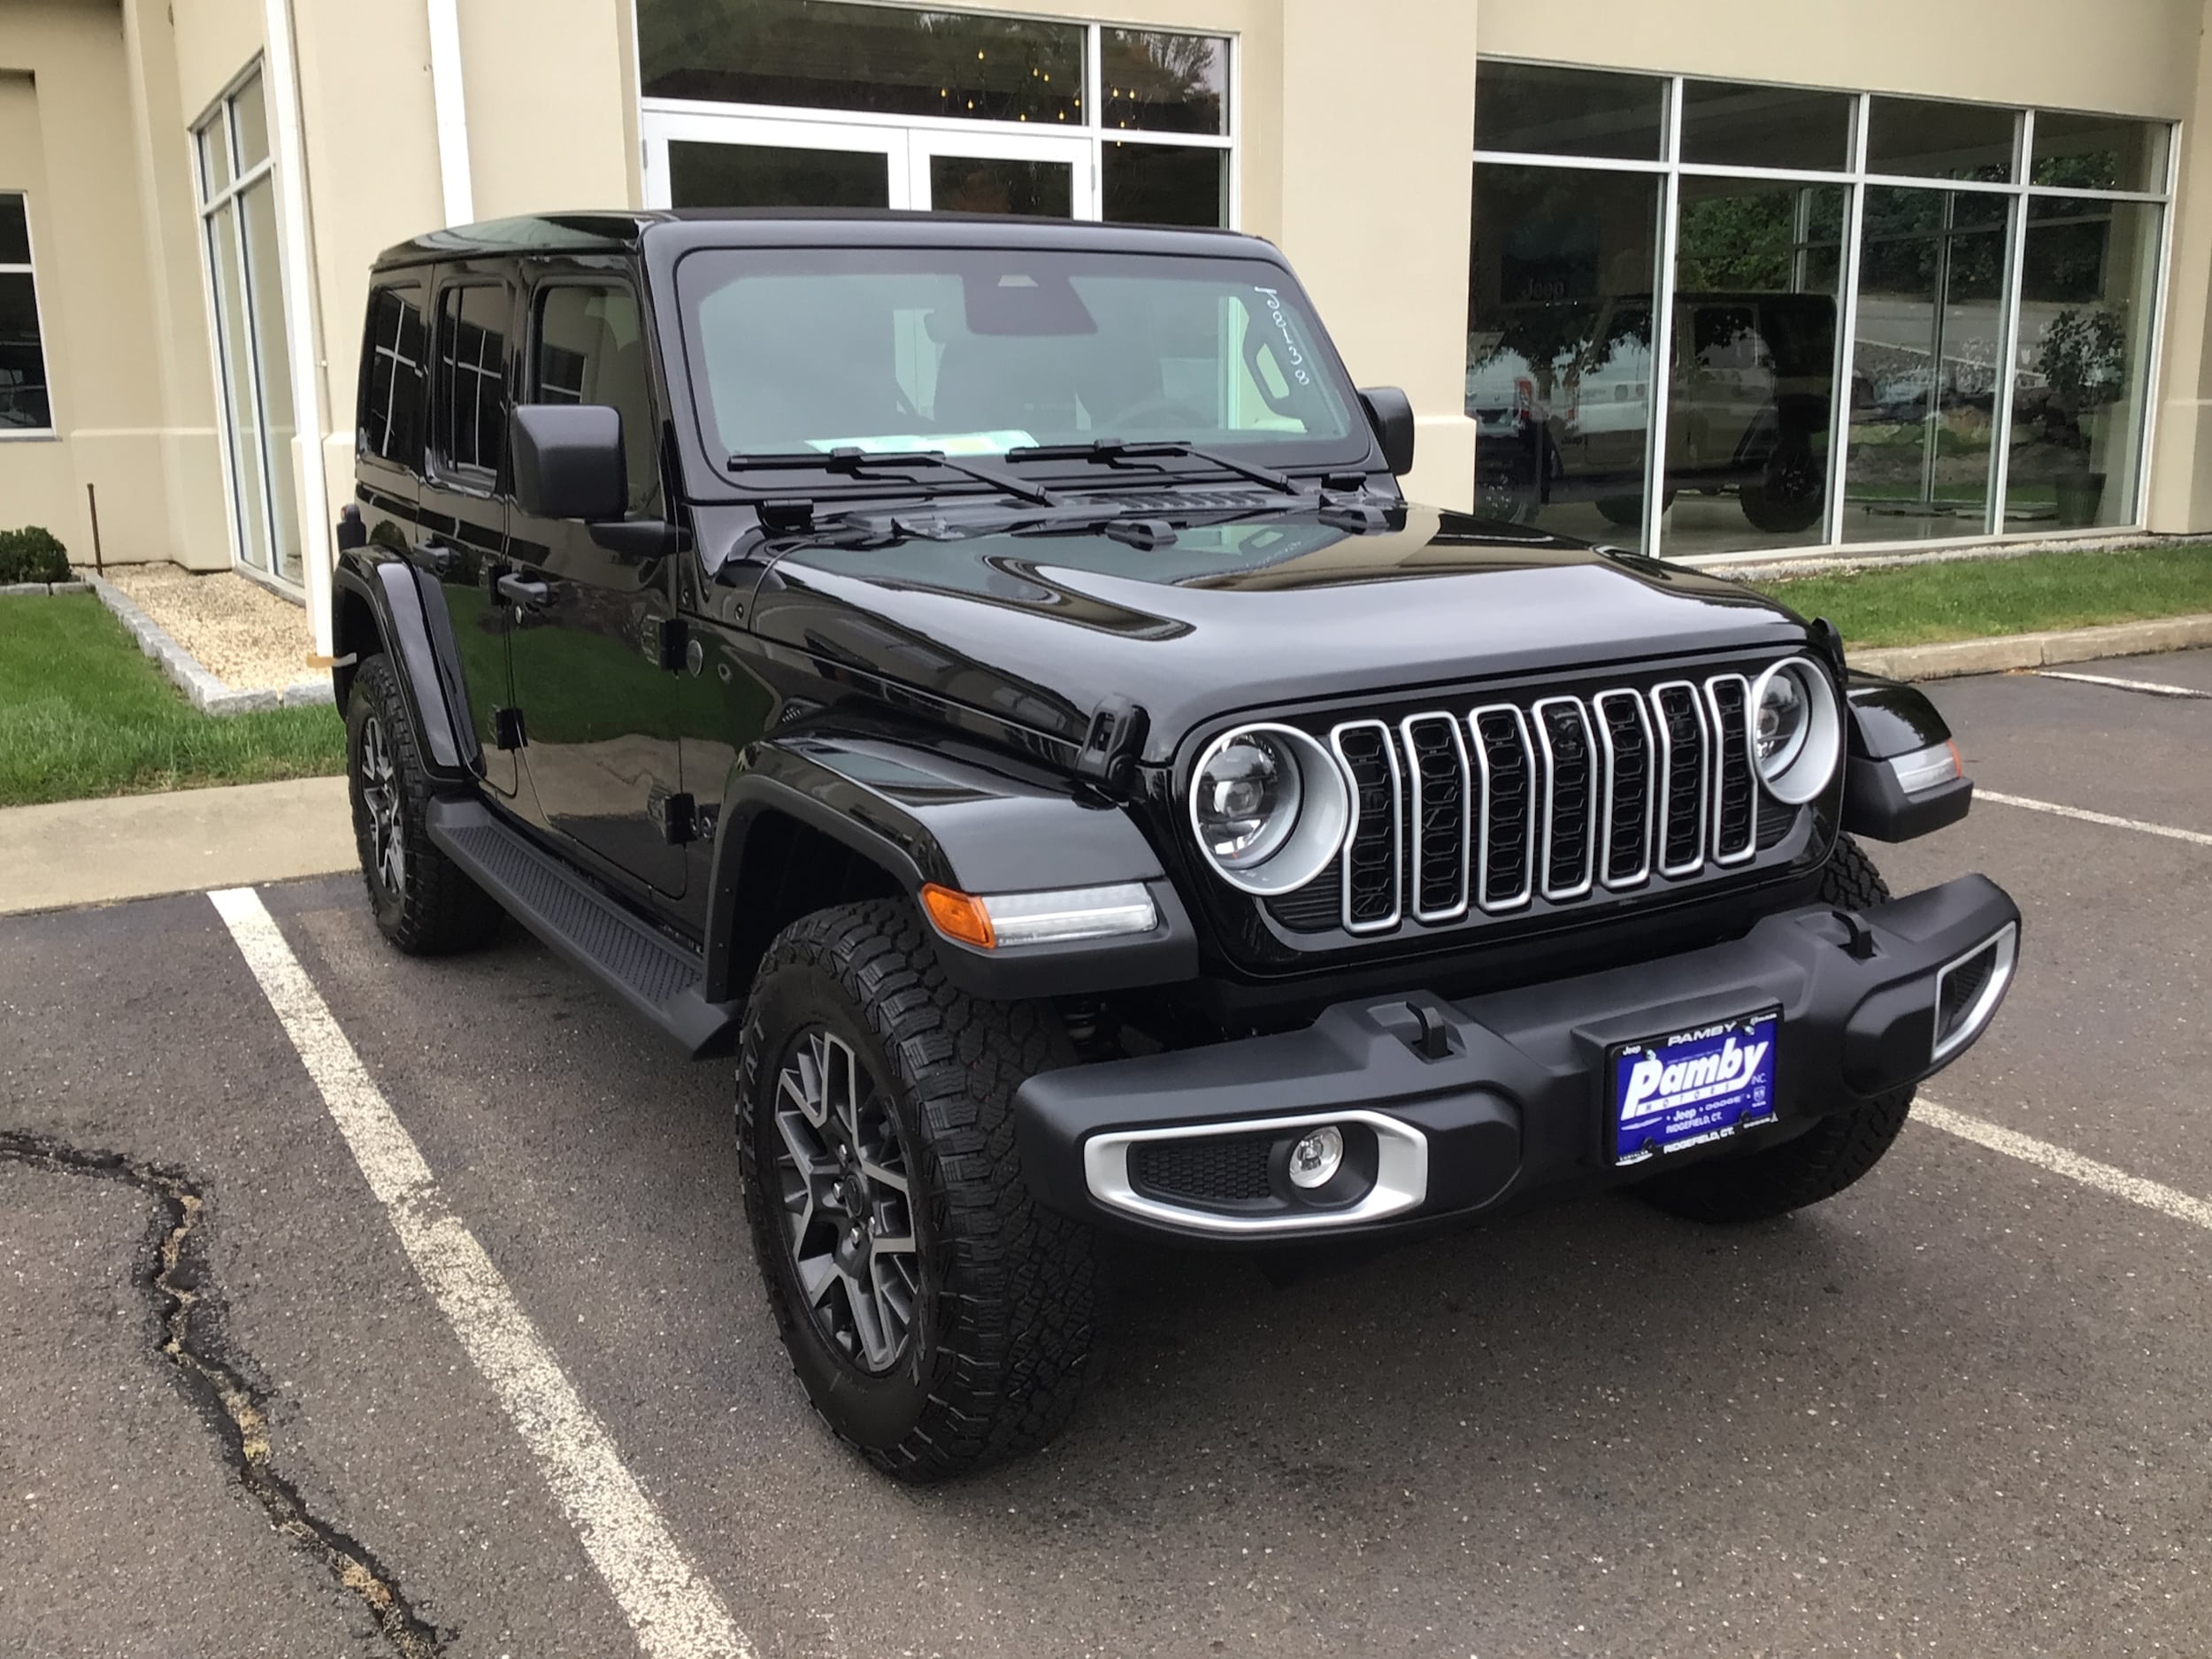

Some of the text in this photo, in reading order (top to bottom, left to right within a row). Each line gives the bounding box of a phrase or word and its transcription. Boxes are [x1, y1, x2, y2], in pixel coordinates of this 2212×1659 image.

[1668, 1021, 1737, 1047] PAMBY
[1622, 1045, 1641, 1056] Jeep
[1621, 1037, 1770, 1121] Pamby
[1646, 1082, 1730, 1114] MOTORS
[1673, 1108, 1697, 1122] Jeep
